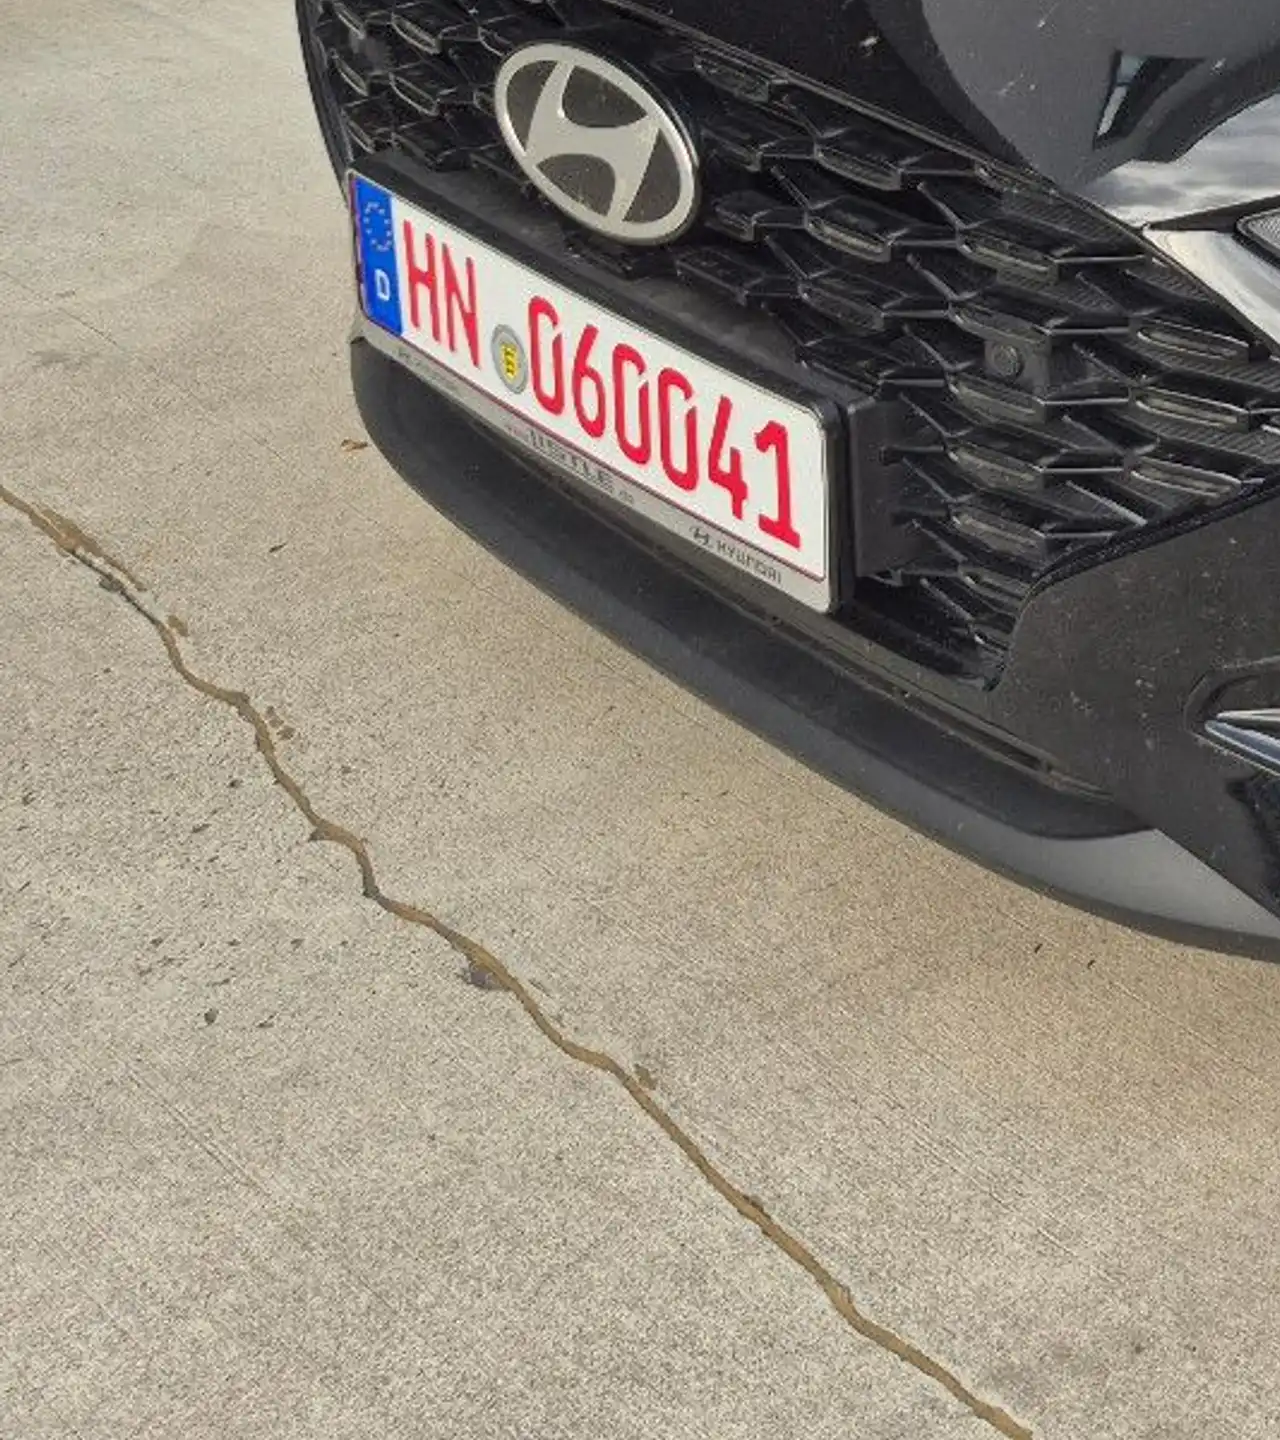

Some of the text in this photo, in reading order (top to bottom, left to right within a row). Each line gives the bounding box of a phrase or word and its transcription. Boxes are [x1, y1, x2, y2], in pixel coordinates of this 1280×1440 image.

[374, 268, 391, 301] D
[403, 219, 801, 550] HN 060041
